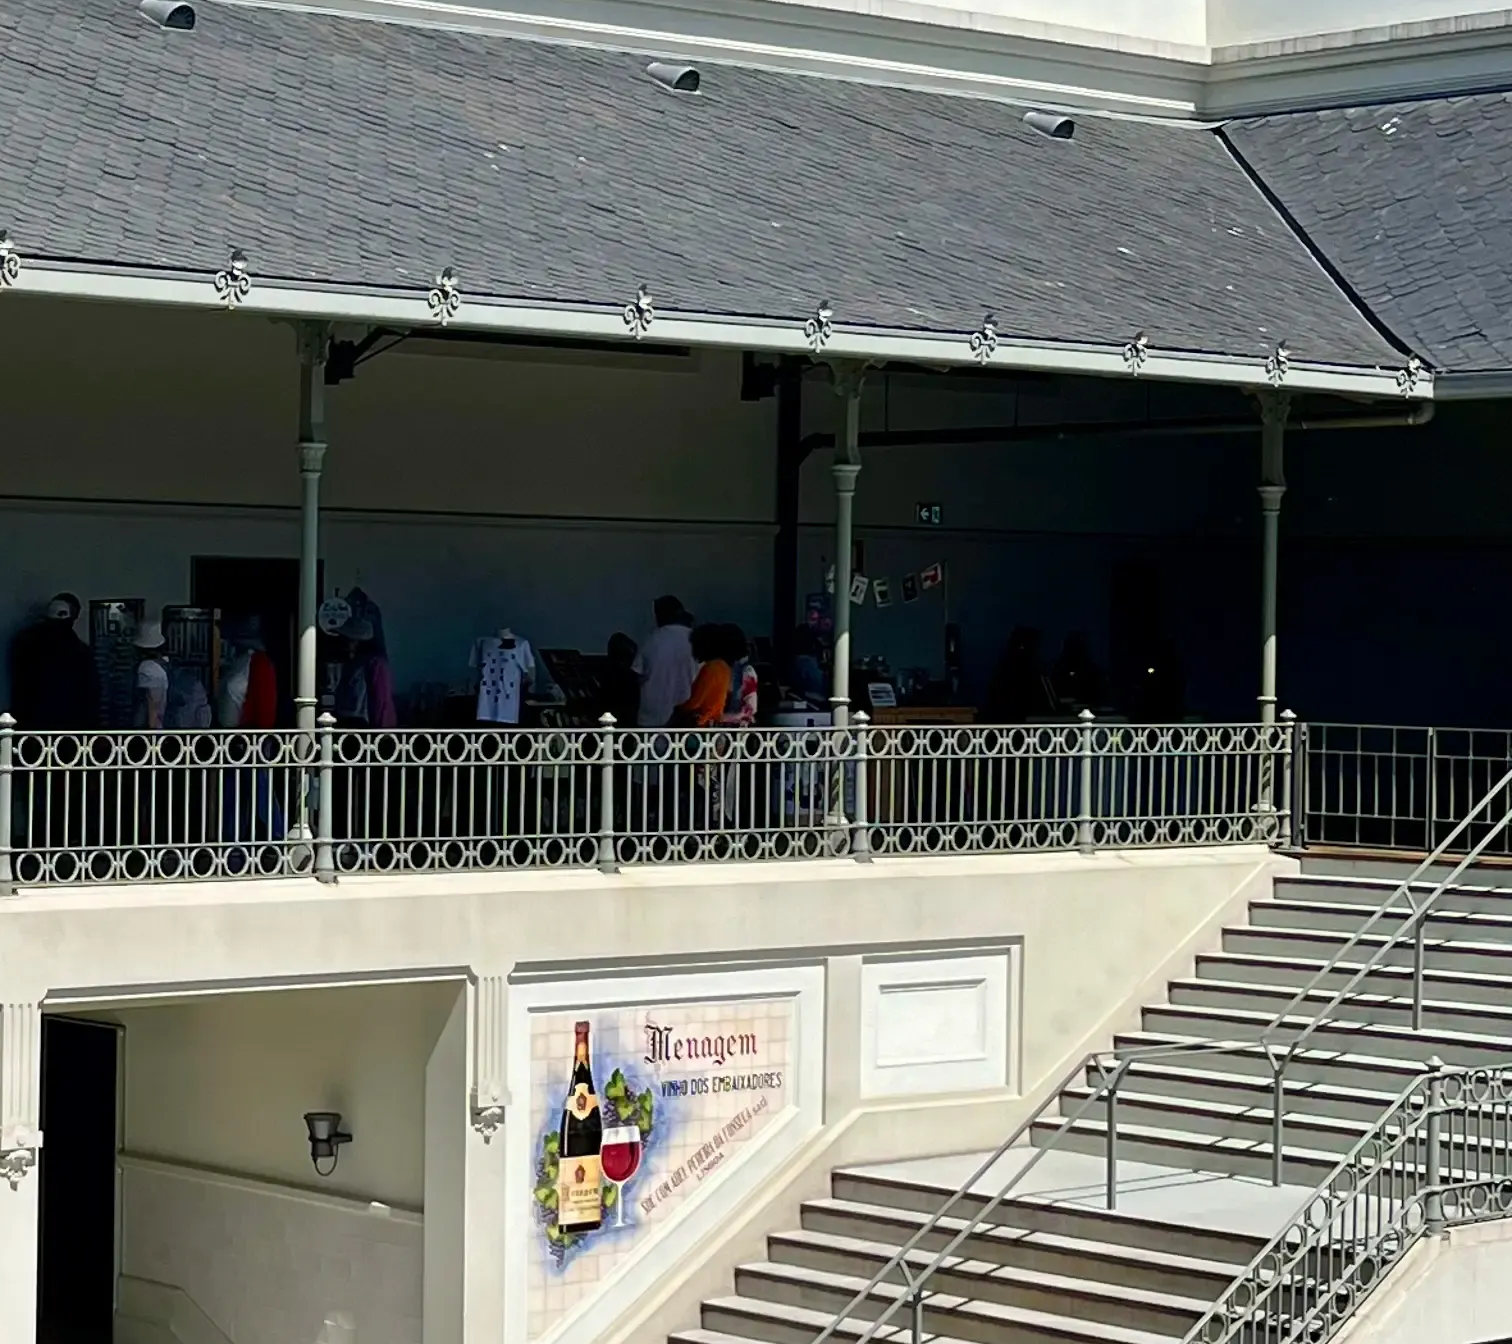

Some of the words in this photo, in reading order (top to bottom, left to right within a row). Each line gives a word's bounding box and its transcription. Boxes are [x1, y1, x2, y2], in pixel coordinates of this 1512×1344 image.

[644, 1023, 758, 1066] Menagem
[661, 1080, 688, 1097] VINHO
[691, 1078, 709, 1095] DOS
[712, 1072, 782, 1093] EMBAIXADORES
